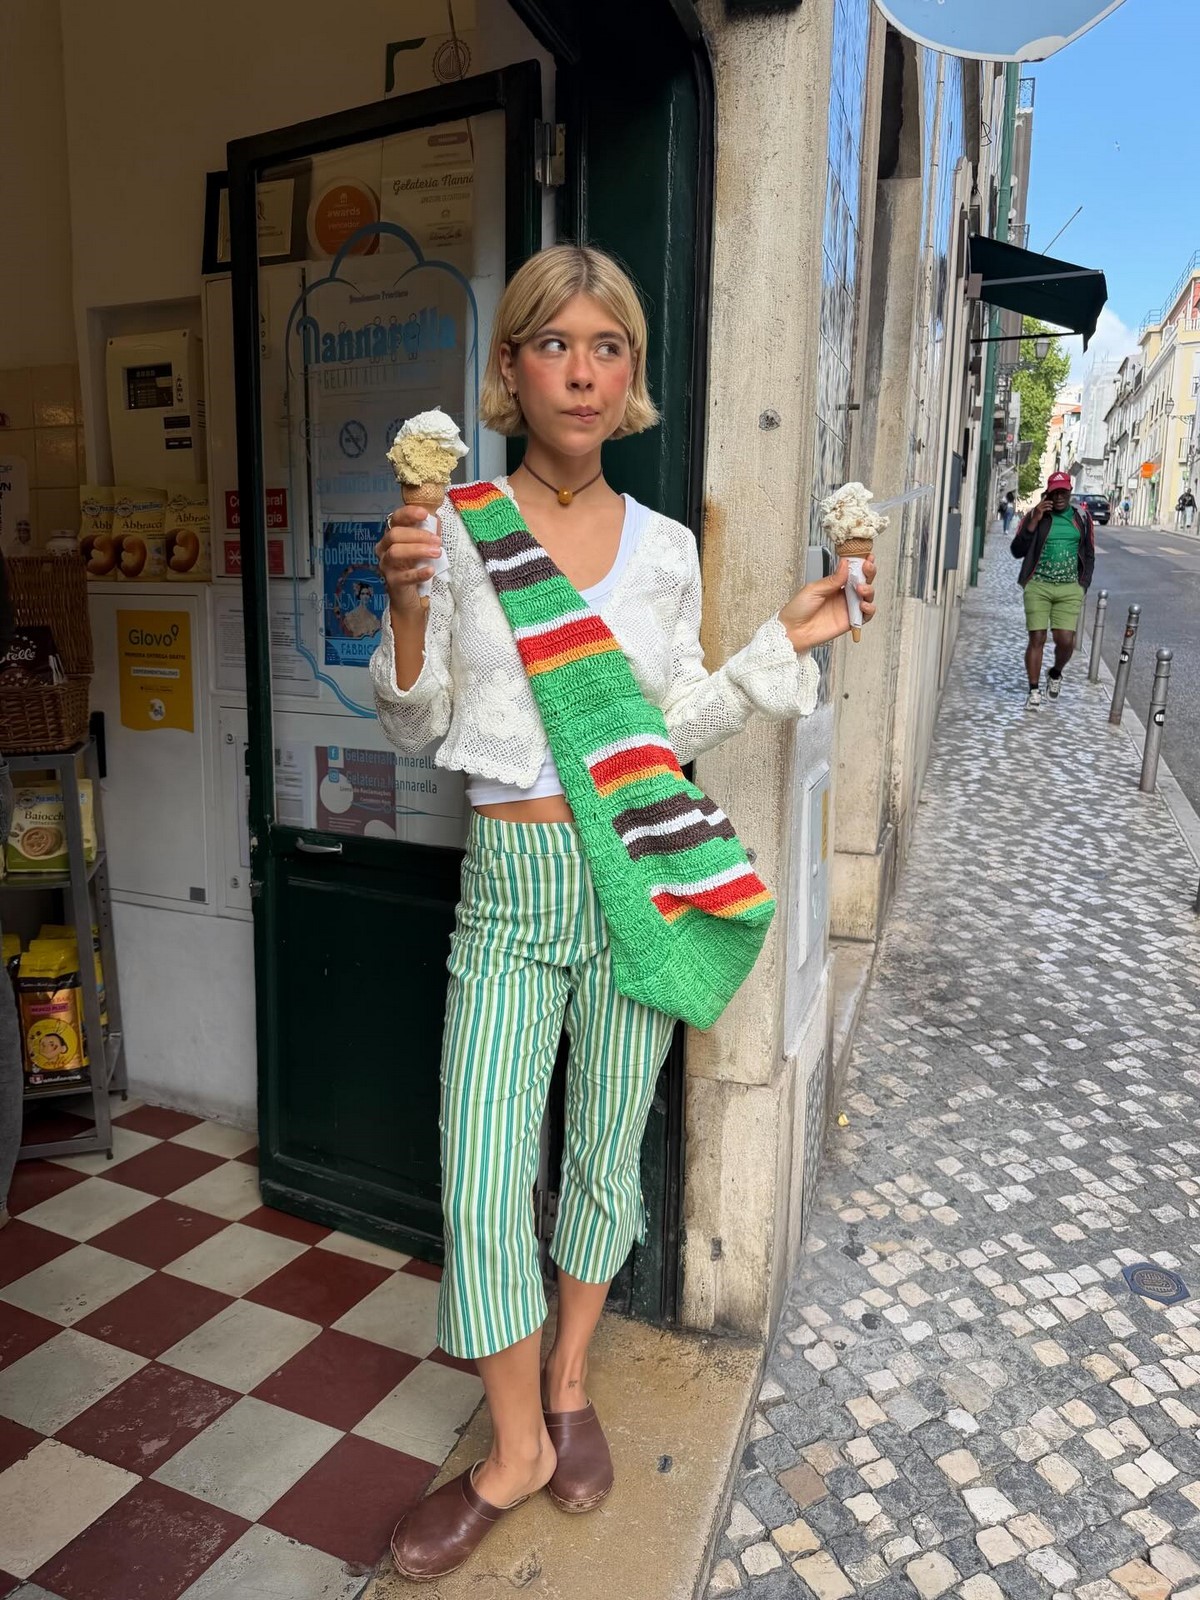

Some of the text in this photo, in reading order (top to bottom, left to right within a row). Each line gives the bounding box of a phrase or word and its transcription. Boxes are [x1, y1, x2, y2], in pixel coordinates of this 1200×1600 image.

[392, 177, 437, 195] Gelateria
[326, 207, 360, 218] awards
[323, 367, 359, 390] GELATI
[122, 518, 163, 530] Abbracci
[354, 528, 371, 541] FESTA
[128, 628, 173, 647] Glovo
[24, 811, 64, 821] Baiocch
